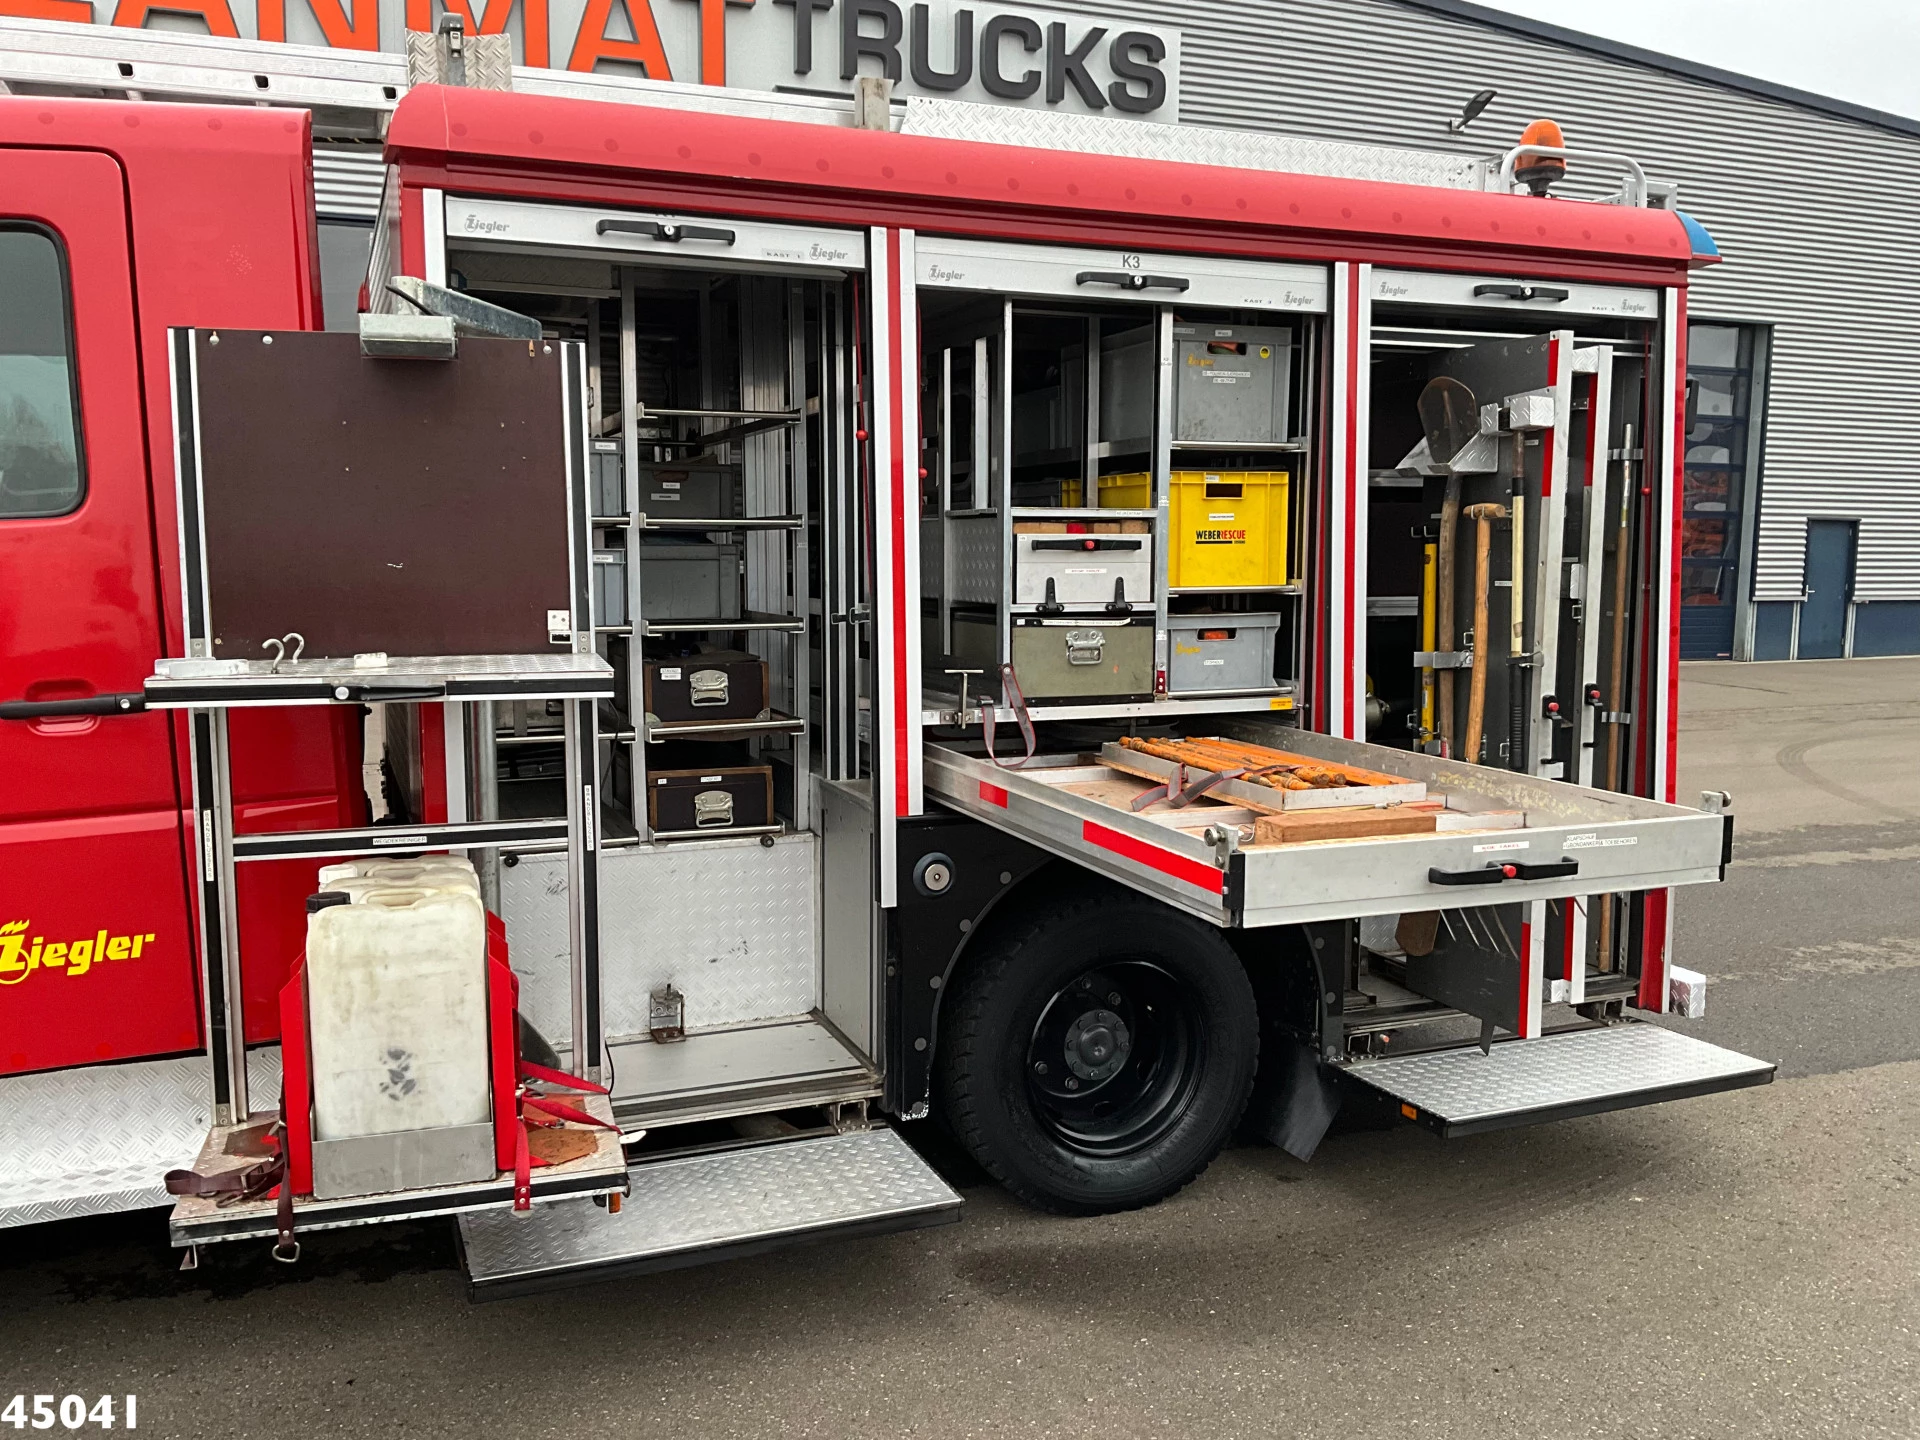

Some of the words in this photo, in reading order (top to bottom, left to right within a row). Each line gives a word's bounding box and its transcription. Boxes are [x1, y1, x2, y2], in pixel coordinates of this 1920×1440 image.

[772, 0, 1167, 114] TRUCKS
[464, 214, 510, 233] Ziegler
[809, 243, 849, 260] Ziegler
[1122, 254, 1140, 268] K3
[928, 264, 965, 281] Ziegler
[1379, 281, 1408, 296] Ziegler
[1283, 291, 1314, 306] Ziegler
[0, 919, 156, 985] Ziegler
